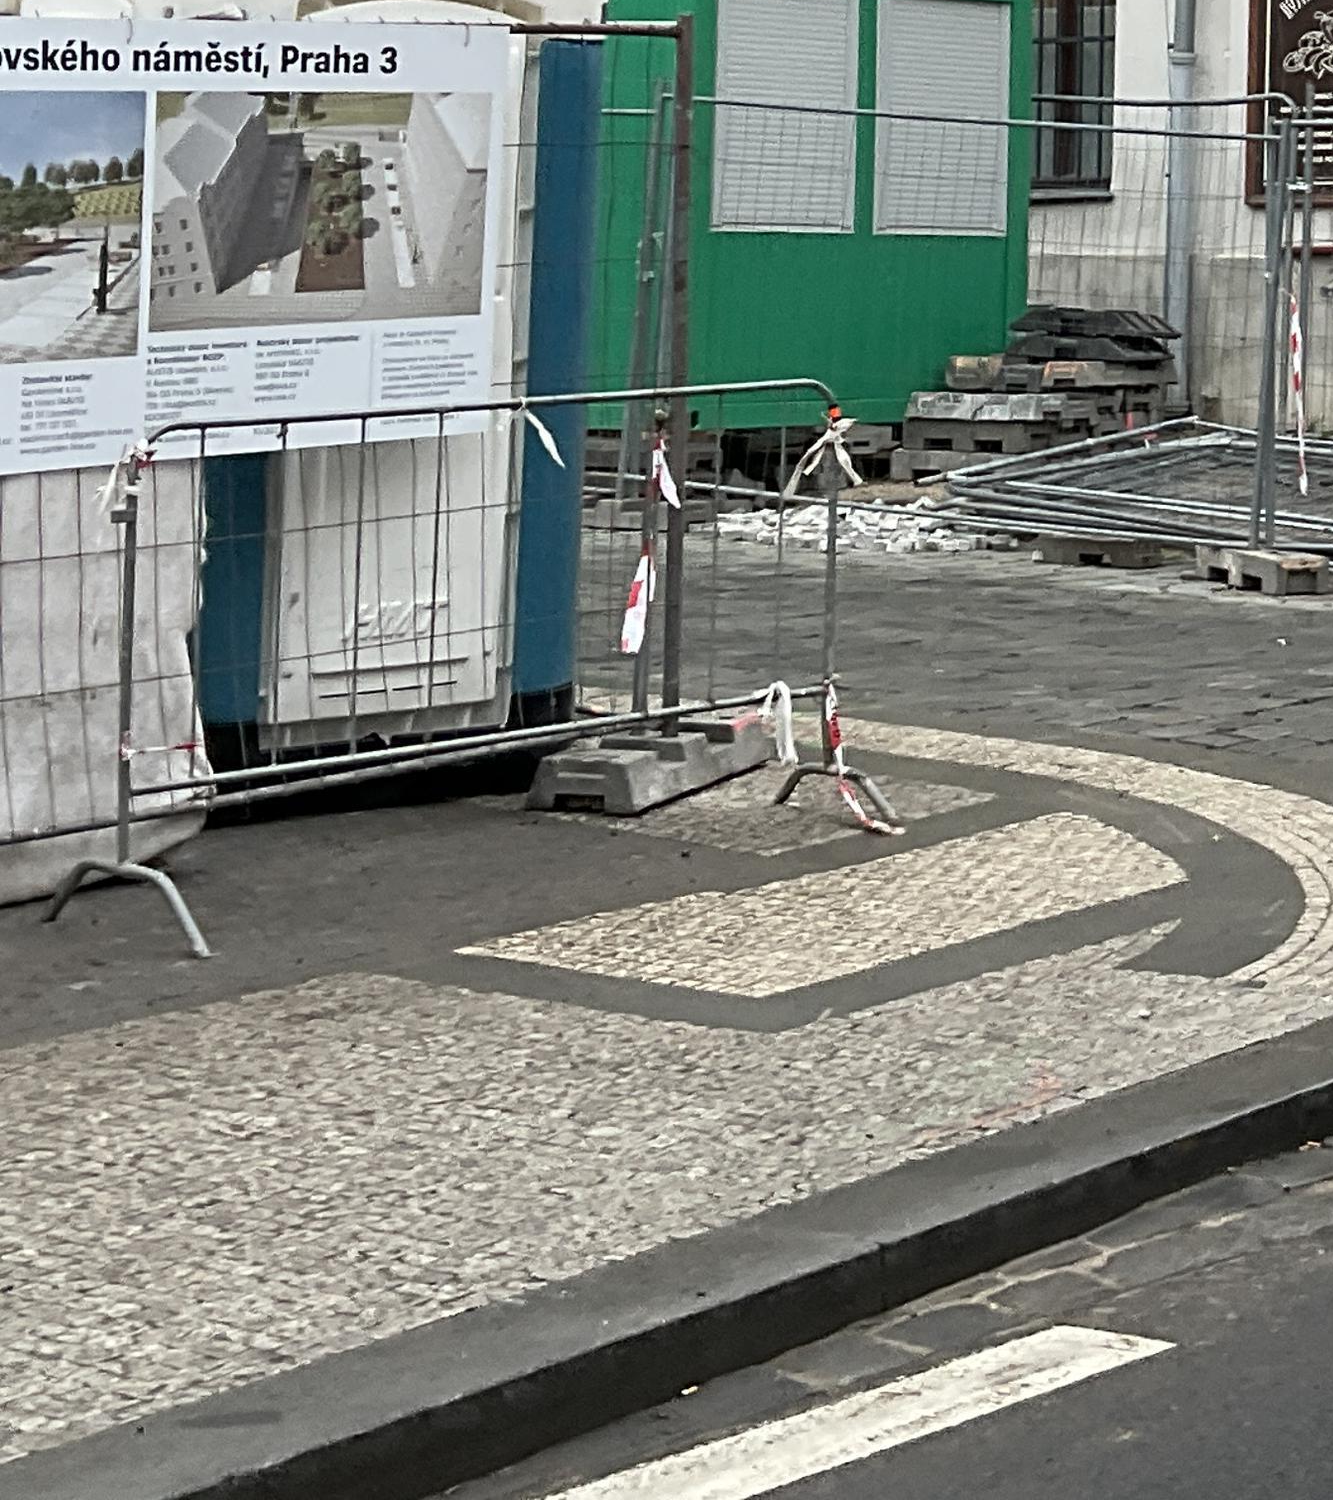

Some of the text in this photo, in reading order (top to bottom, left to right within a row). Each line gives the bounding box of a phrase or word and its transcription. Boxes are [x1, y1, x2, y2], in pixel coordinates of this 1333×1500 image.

[131, 41, 270, 79] náměstí,
[279, 44, 369, 75] Praha
[379, 46, 399, 75] 3
